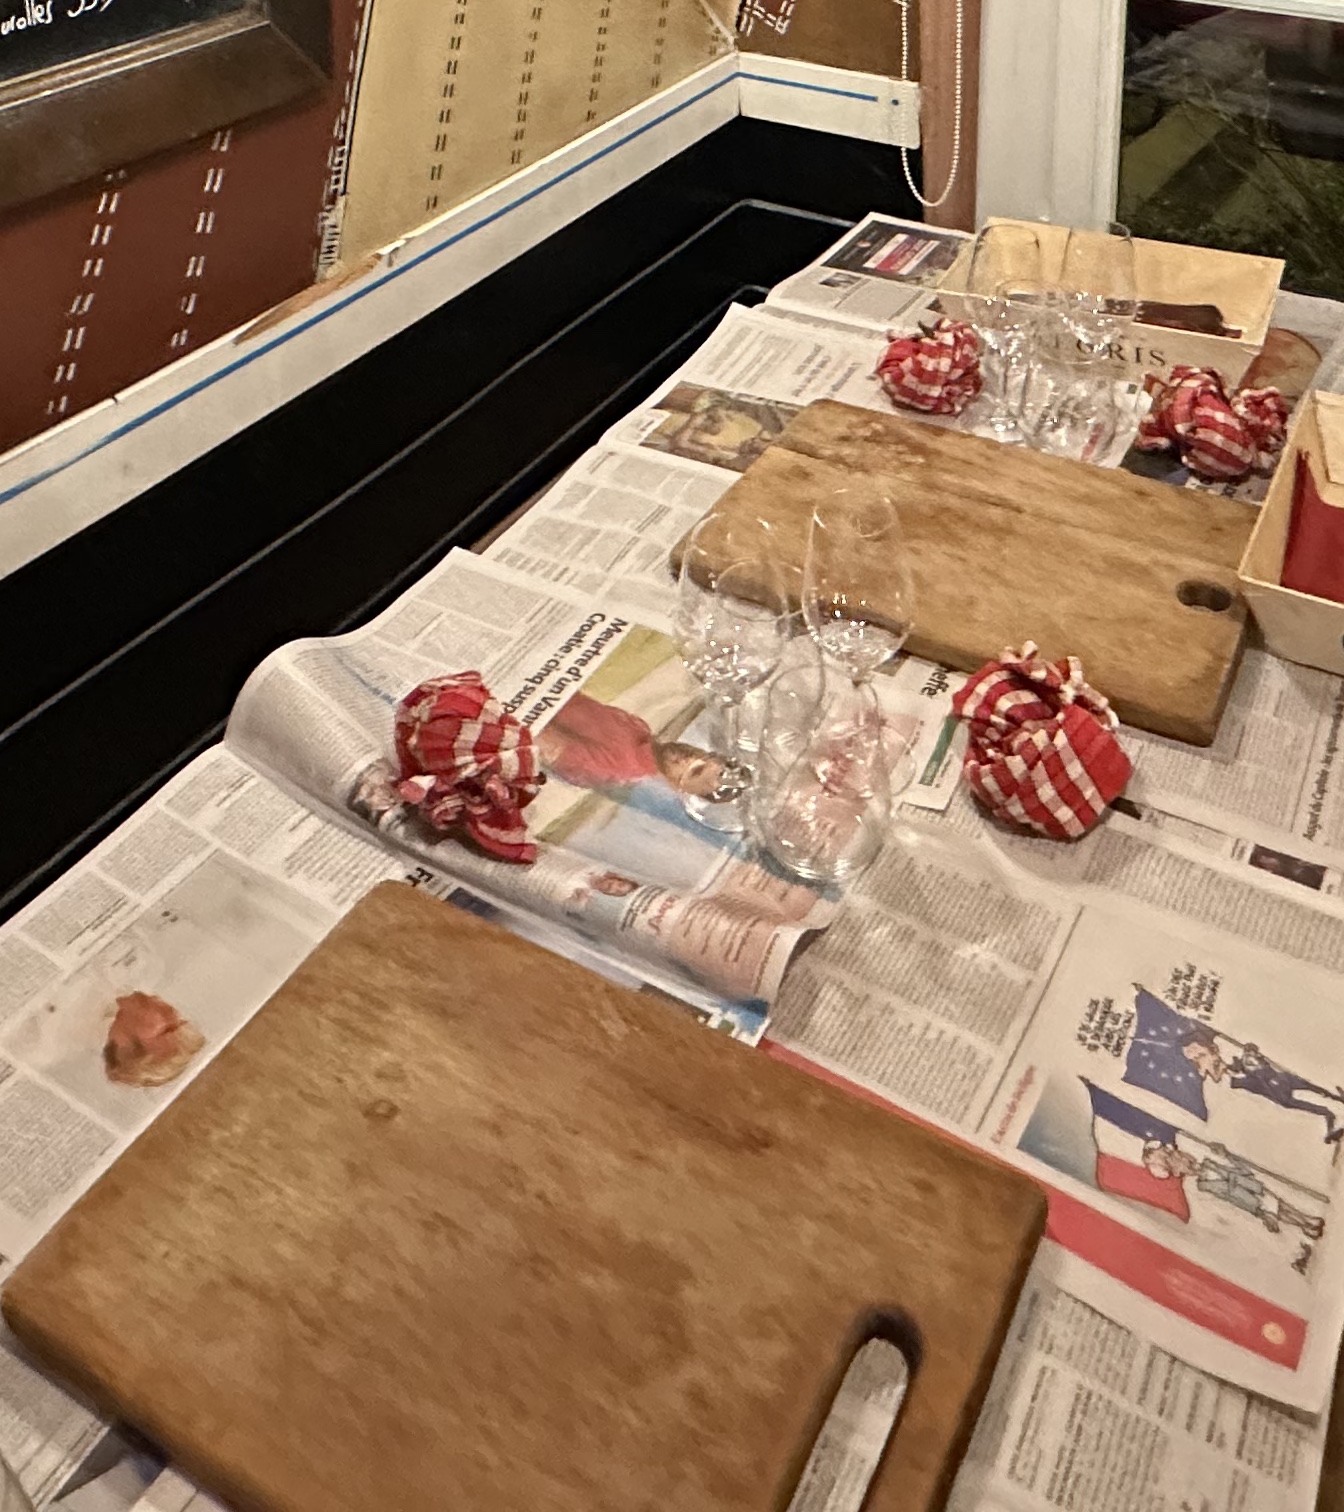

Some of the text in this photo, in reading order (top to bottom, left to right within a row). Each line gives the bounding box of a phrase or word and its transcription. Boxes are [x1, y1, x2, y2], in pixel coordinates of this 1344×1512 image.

[558, 611, 605, 656] Croatie
[574, 618, 626, 668] Meurtre
[523, 658, 559, 686] cinq
[548, 665, 581, 697] d'un
